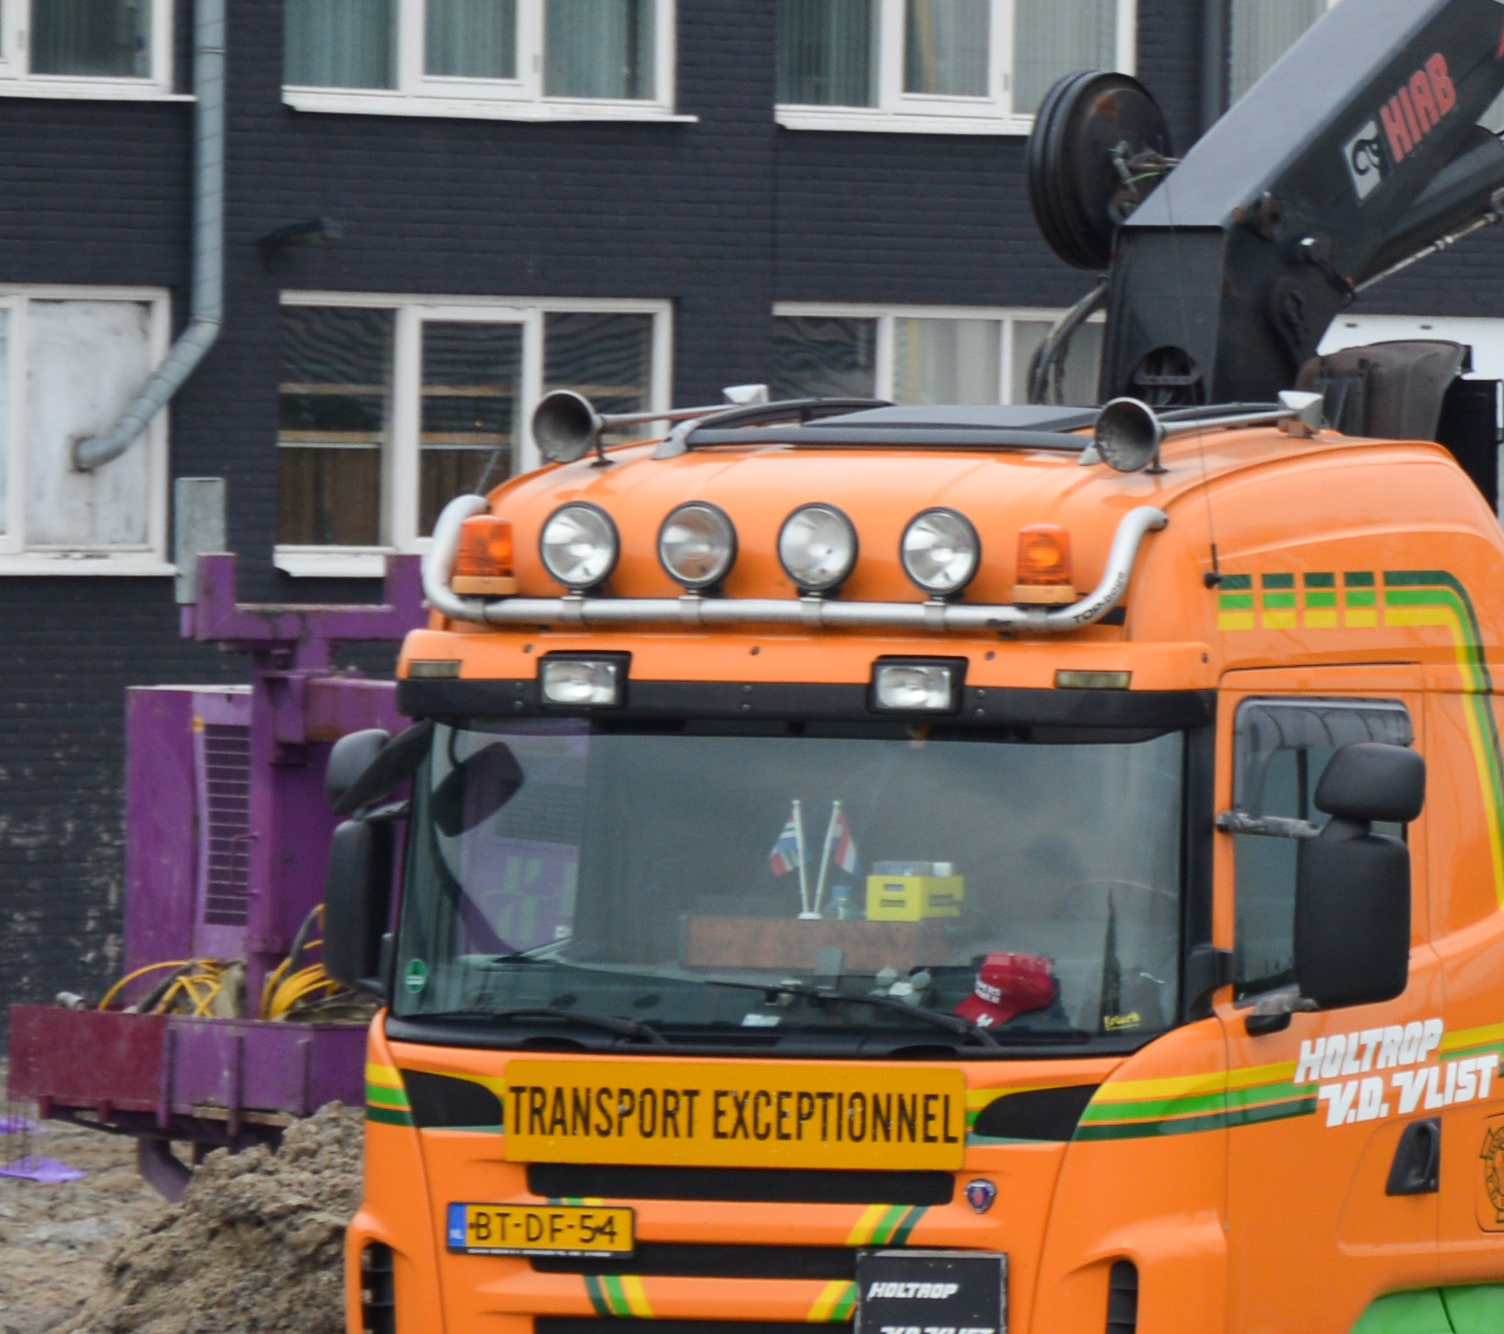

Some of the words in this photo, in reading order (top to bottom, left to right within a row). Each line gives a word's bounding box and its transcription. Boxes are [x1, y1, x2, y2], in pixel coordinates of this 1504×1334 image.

[1379, 52, 1457, 163] HIAB
[1294, 1018, 1444, 1084] HOLTROP
[509, 1085, 700, 1139] TRANSPORT
[713, 1089, 960, 1144] EXCEPTIONNEL
[1318, 1076, 1390, 1127] V.D.
[1391, 1054, 1499, 1114] VLIST
[473, 1211, 617, 1244] BT-DF-54
[867, 1281, 960, 1300] HOLTROP
